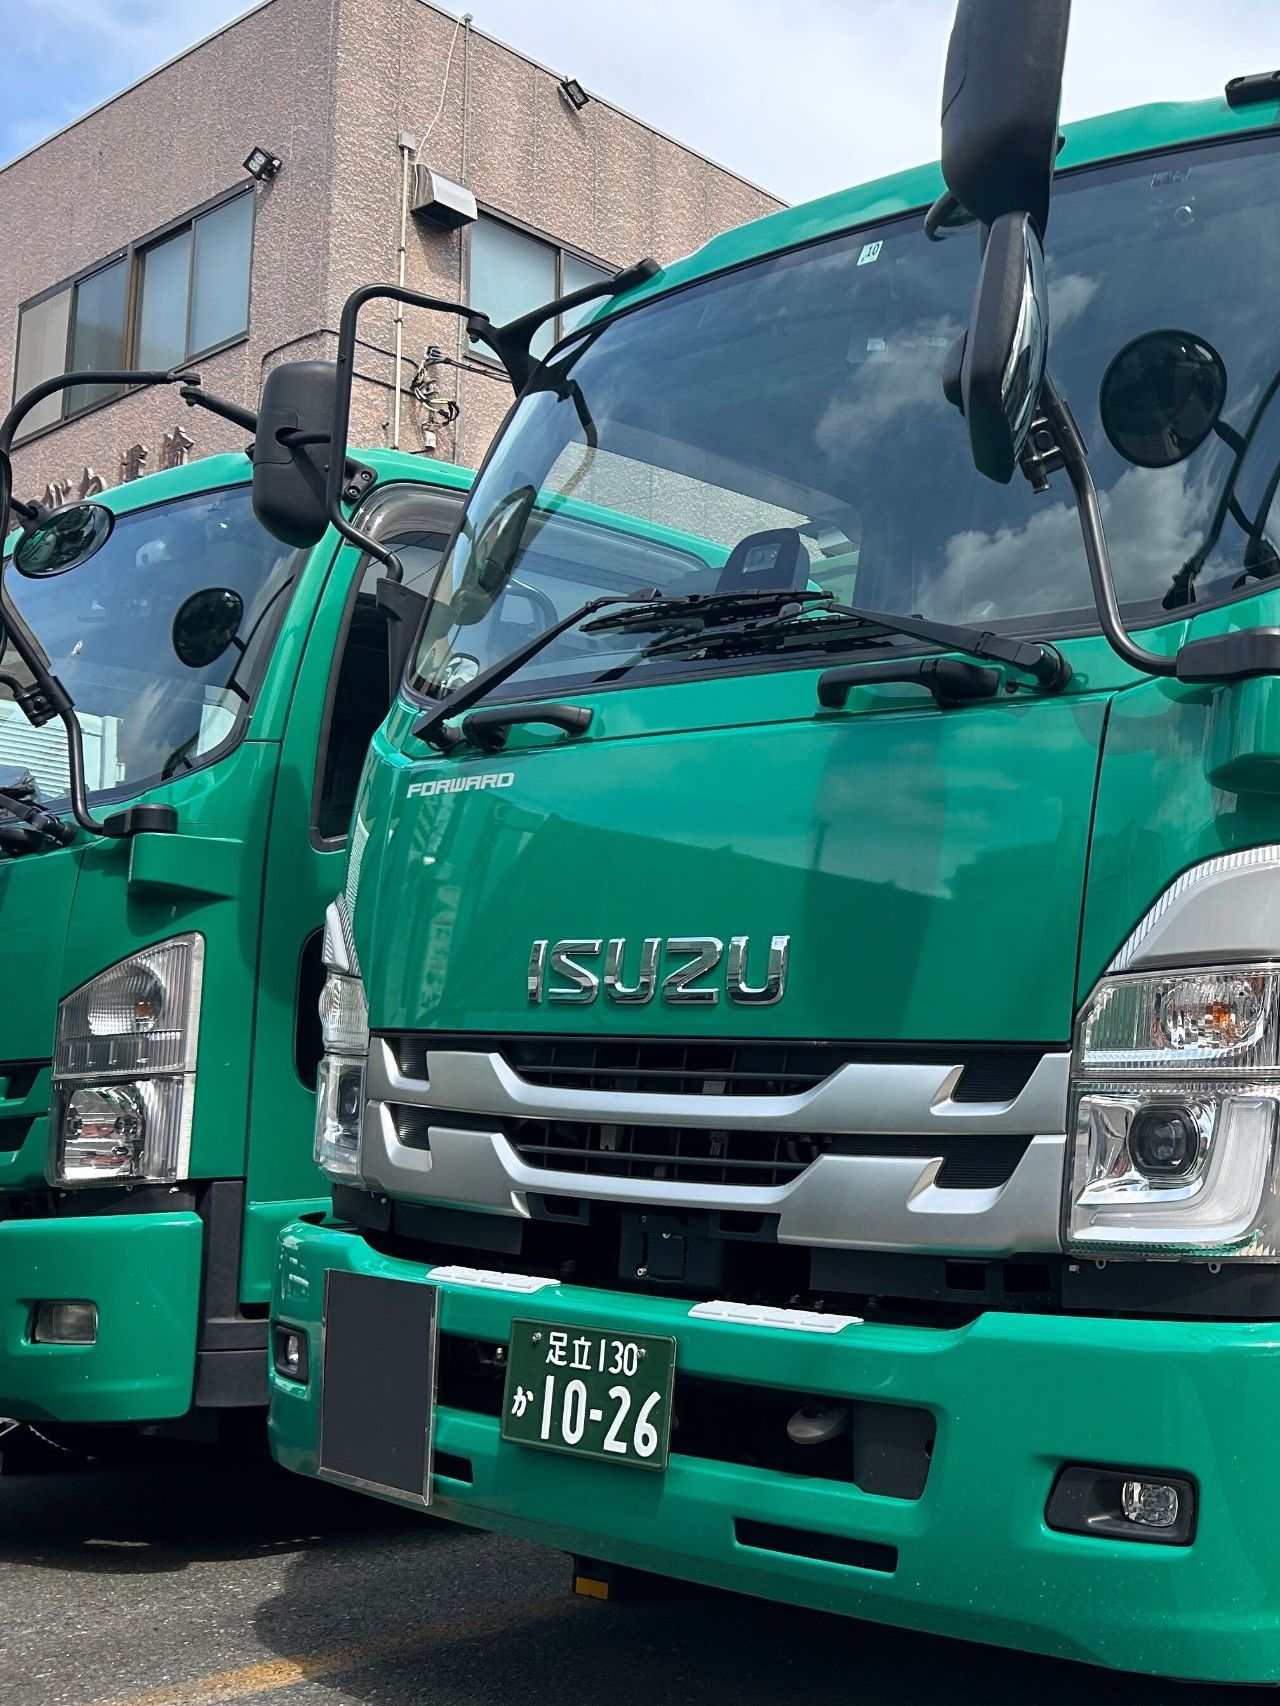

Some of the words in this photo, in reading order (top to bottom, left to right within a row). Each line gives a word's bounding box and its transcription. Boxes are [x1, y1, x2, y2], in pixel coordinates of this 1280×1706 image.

[406, 772, 515, 799] FORWARD
[527, 935, 790, 1005] ISUZU
[511, 1385, 533, 1417] か
[540, 1374, 661, 1458] 10-26
